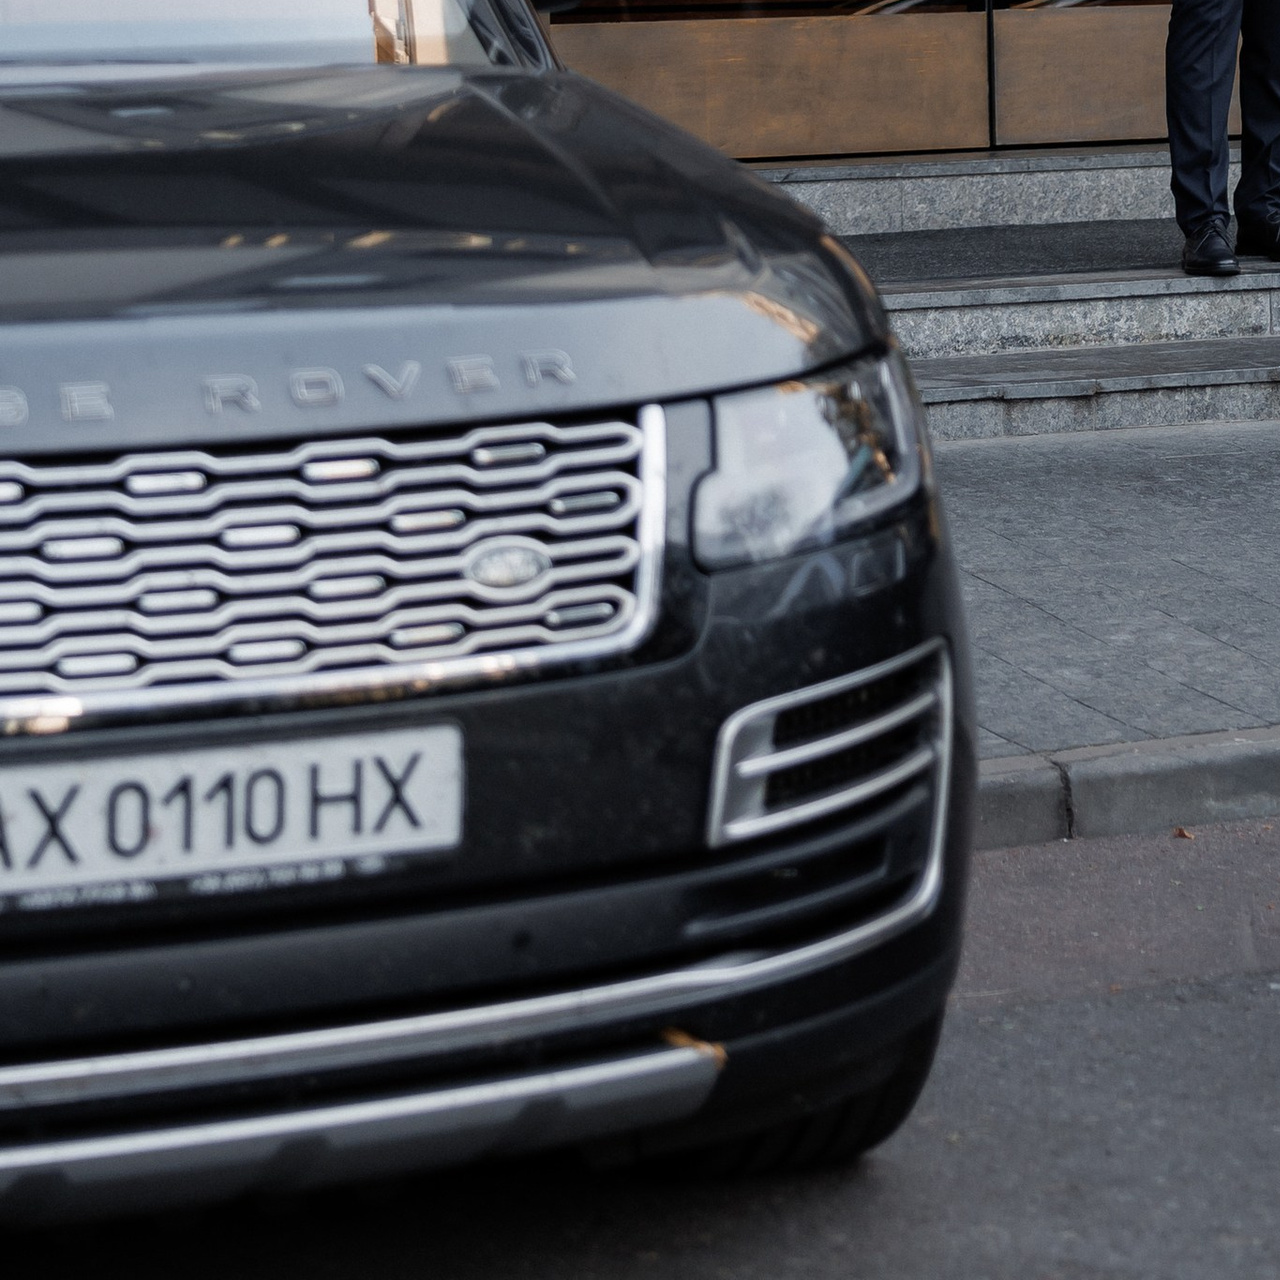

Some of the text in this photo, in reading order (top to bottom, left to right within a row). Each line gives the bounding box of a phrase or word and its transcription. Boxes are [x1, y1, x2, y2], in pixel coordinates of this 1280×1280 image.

[205, 347, 577, 414] ROVER
[0, 751, 425, 870] X 0110 HX
